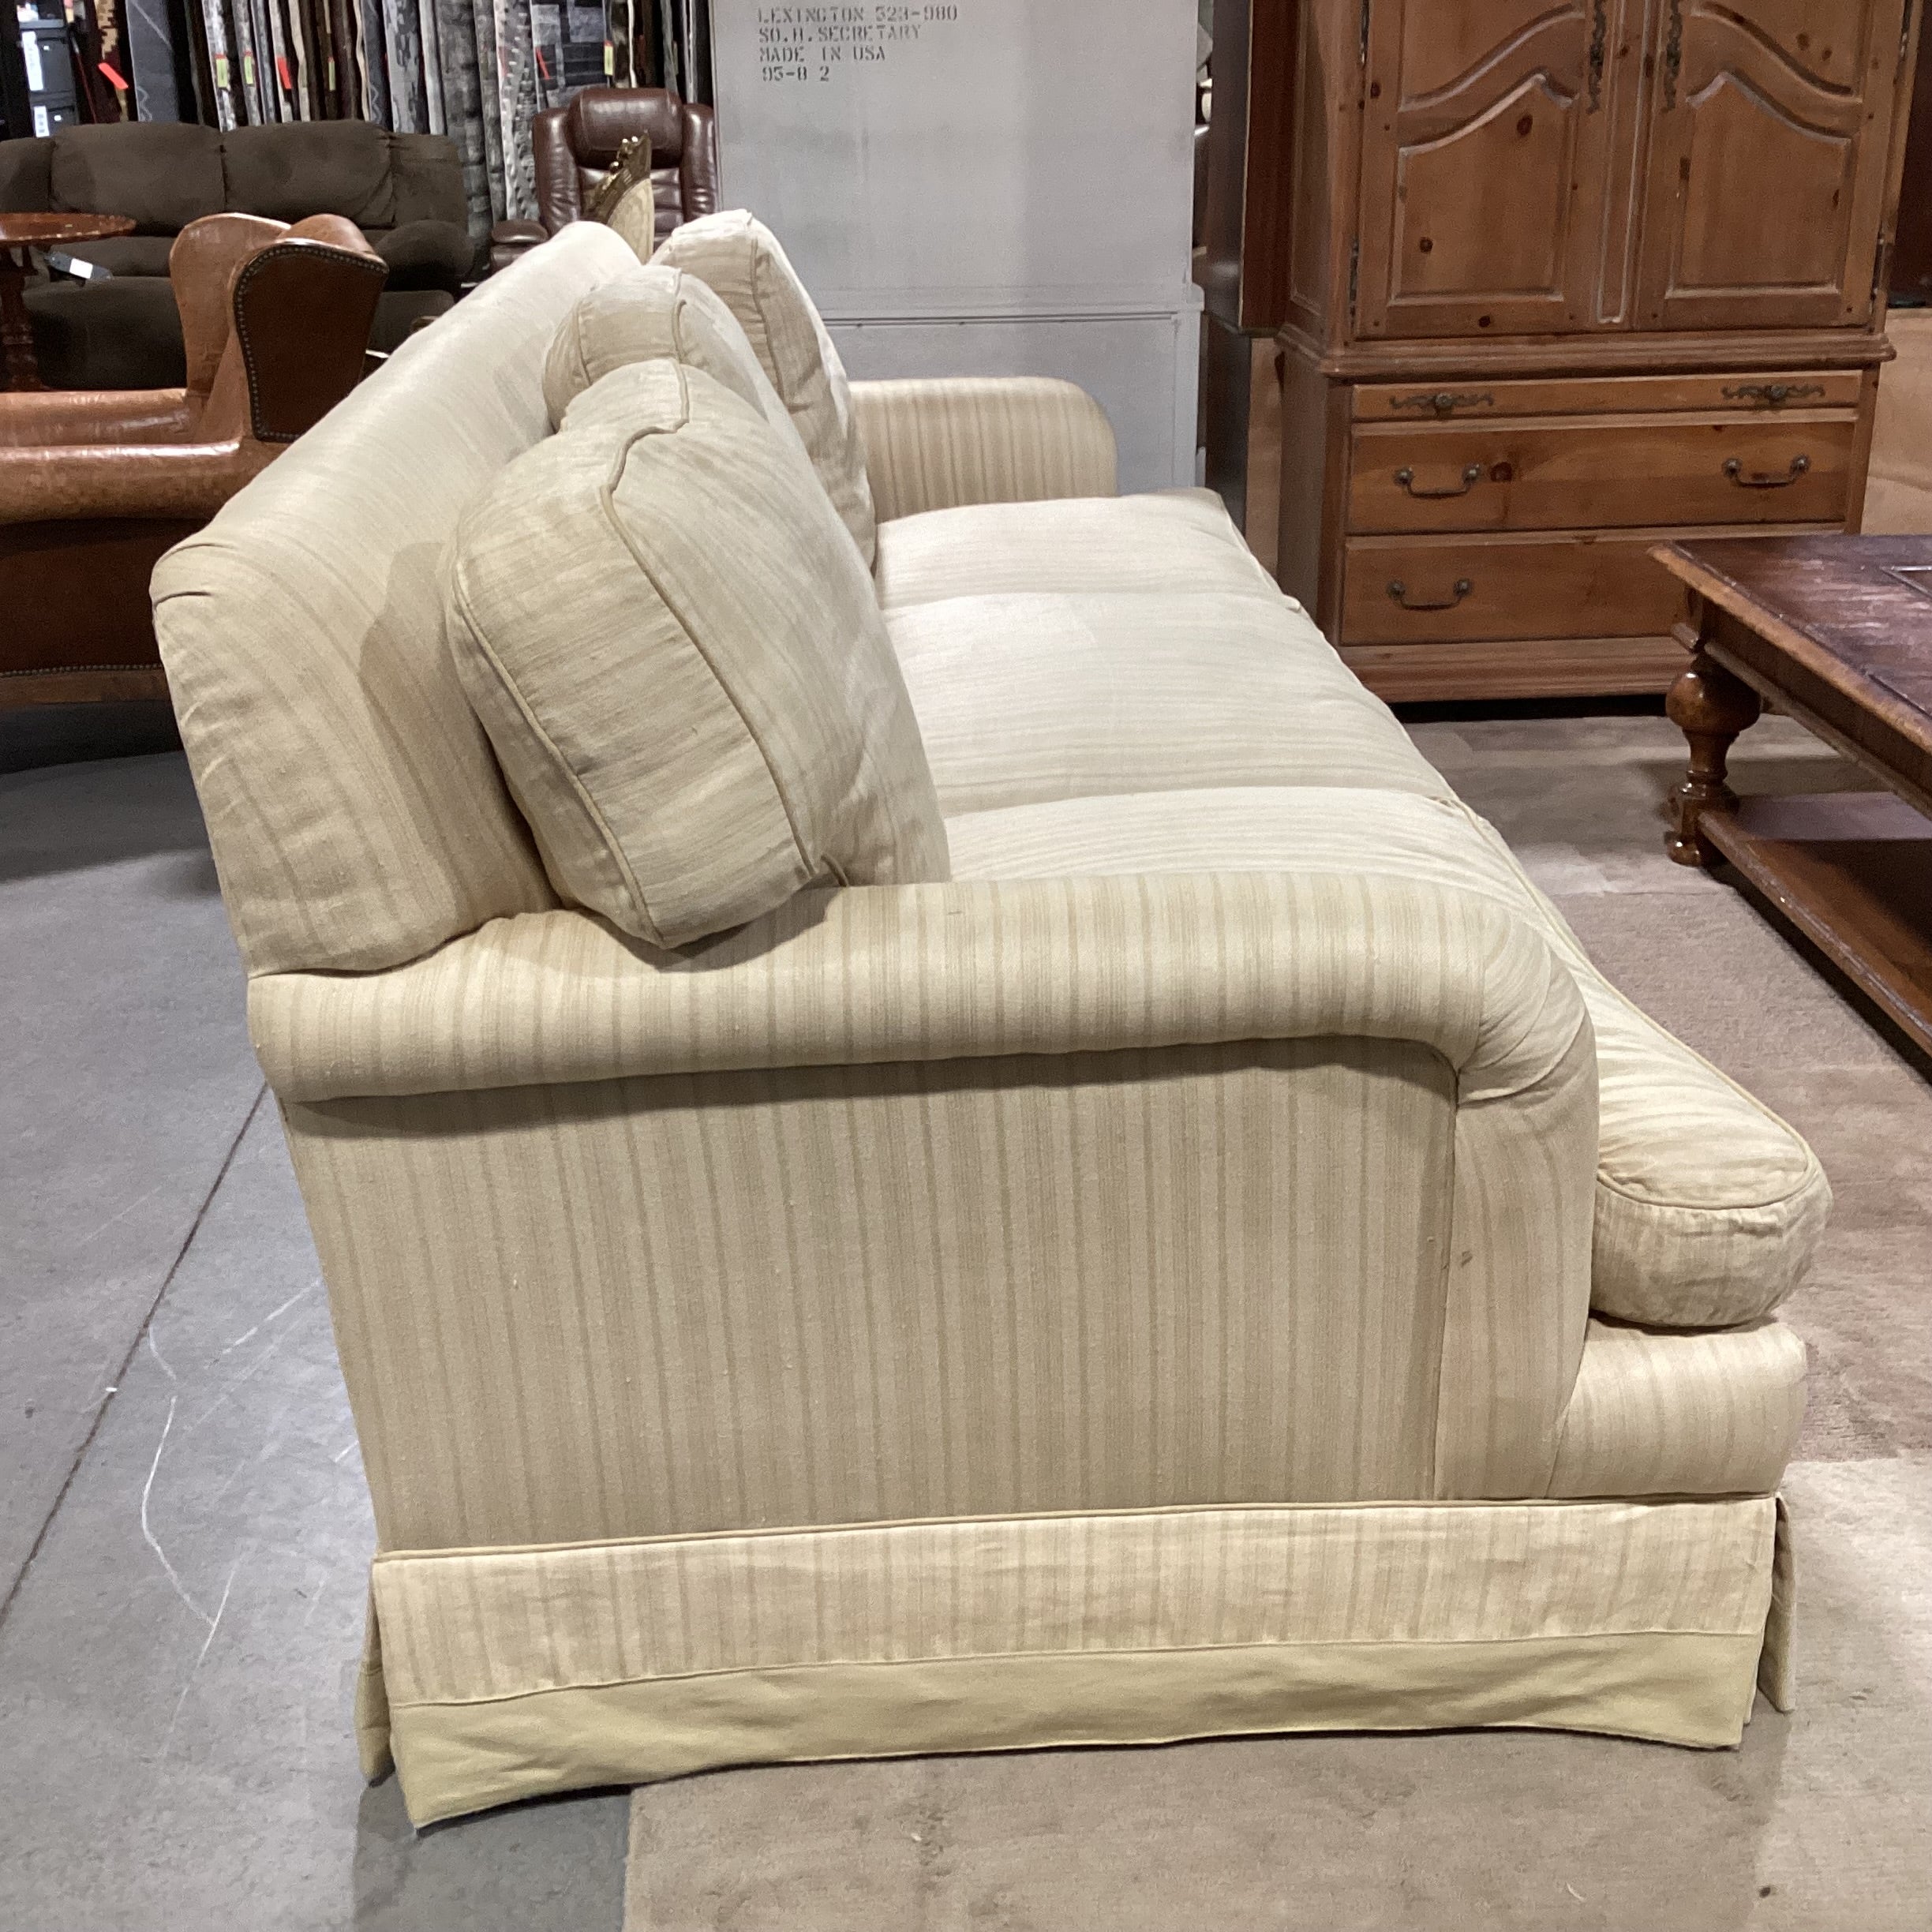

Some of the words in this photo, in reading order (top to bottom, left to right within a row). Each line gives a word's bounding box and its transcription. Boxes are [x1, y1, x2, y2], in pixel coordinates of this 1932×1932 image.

[758, 6, 864, 24] LEXINGTON
[759, 46, 805, 62] MADE
[822, 46, 841, 61] IN
[852, 45, 886, 61] USA
[819, 66, 830, 82] 2
